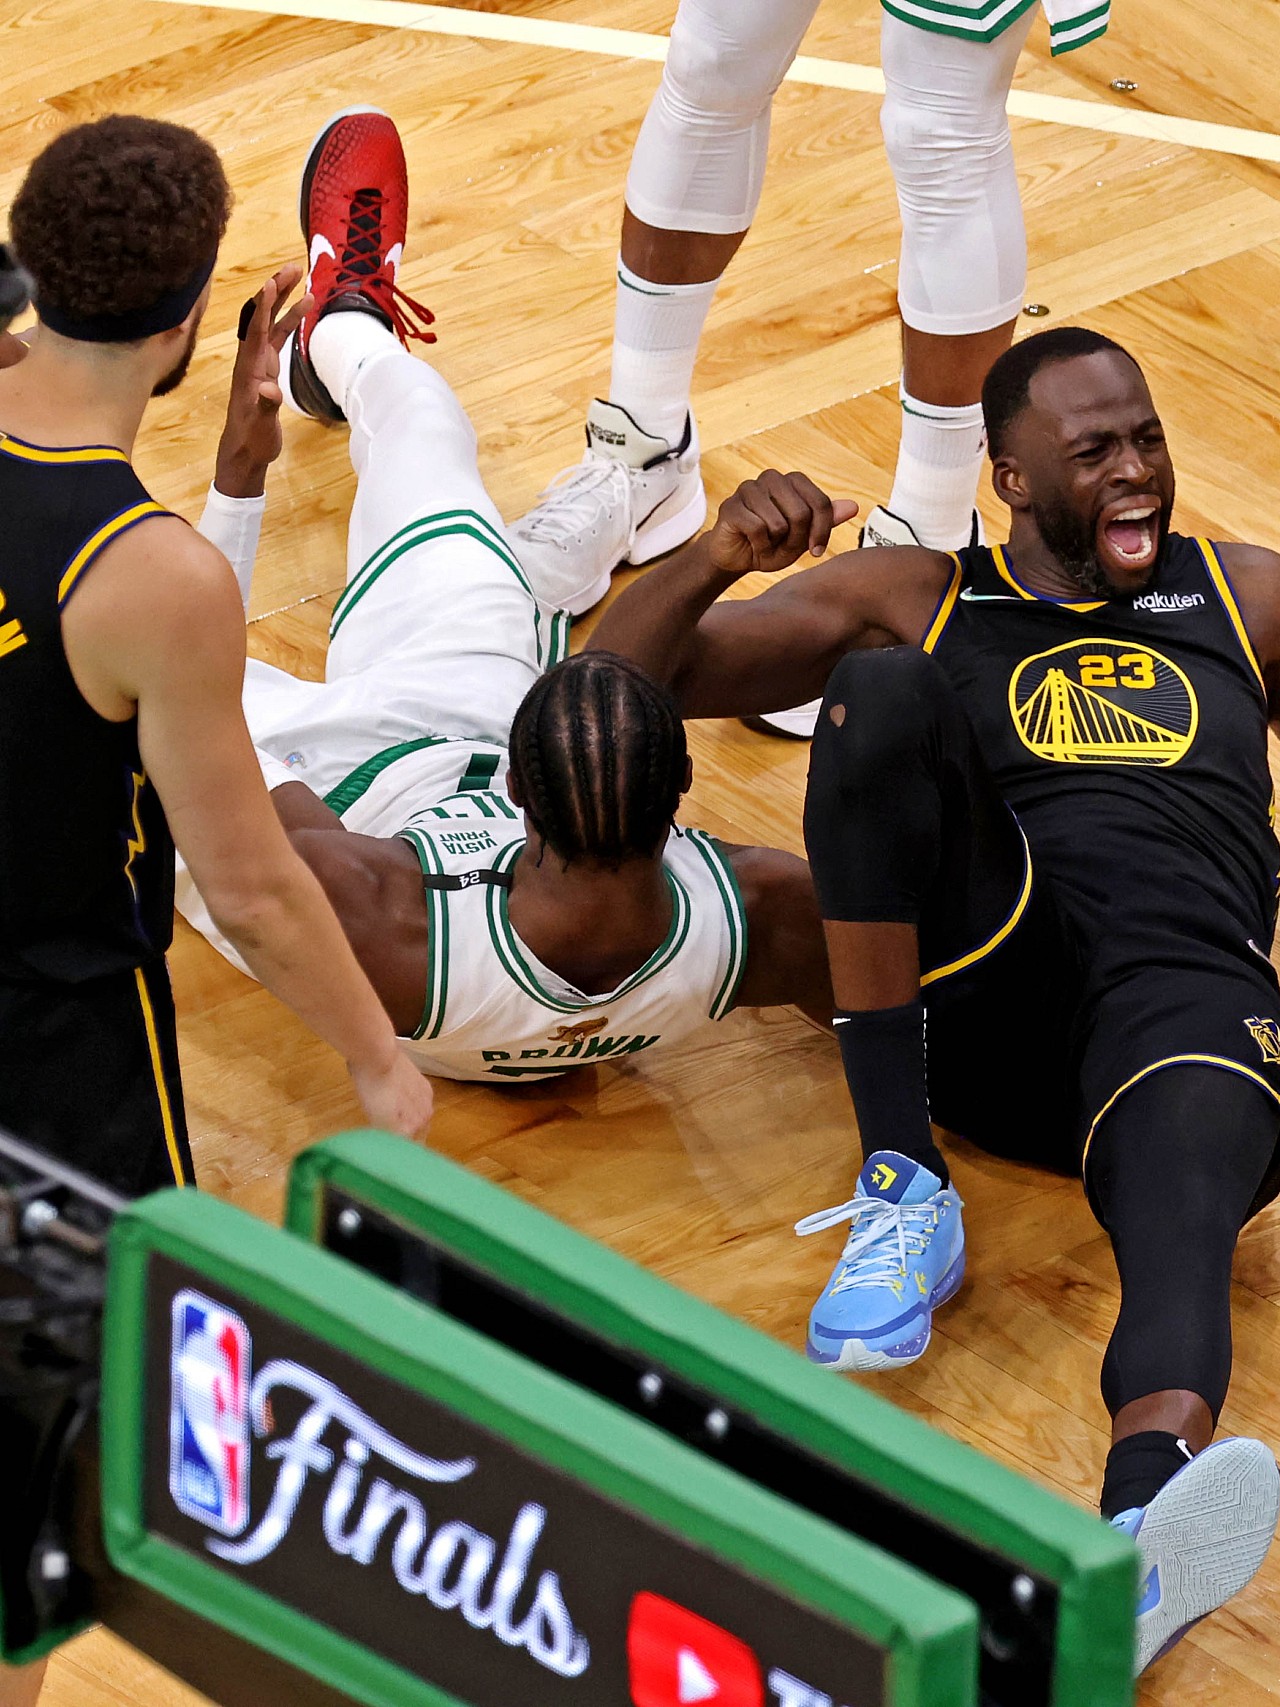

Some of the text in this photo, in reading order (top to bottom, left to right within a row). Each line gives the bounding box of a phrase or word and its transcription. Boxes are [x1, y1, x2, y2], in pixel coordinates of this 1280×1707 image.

[1132, 591, 1206, 612] Rakuten
[1078, 652, 1156, 690] 23
[439, 829, 491, 842] PRINT
[442, 837, 498, 855] VISTA
[458, 871, 481, 888] 24
[204, 1357, 591, 1678] Finals
